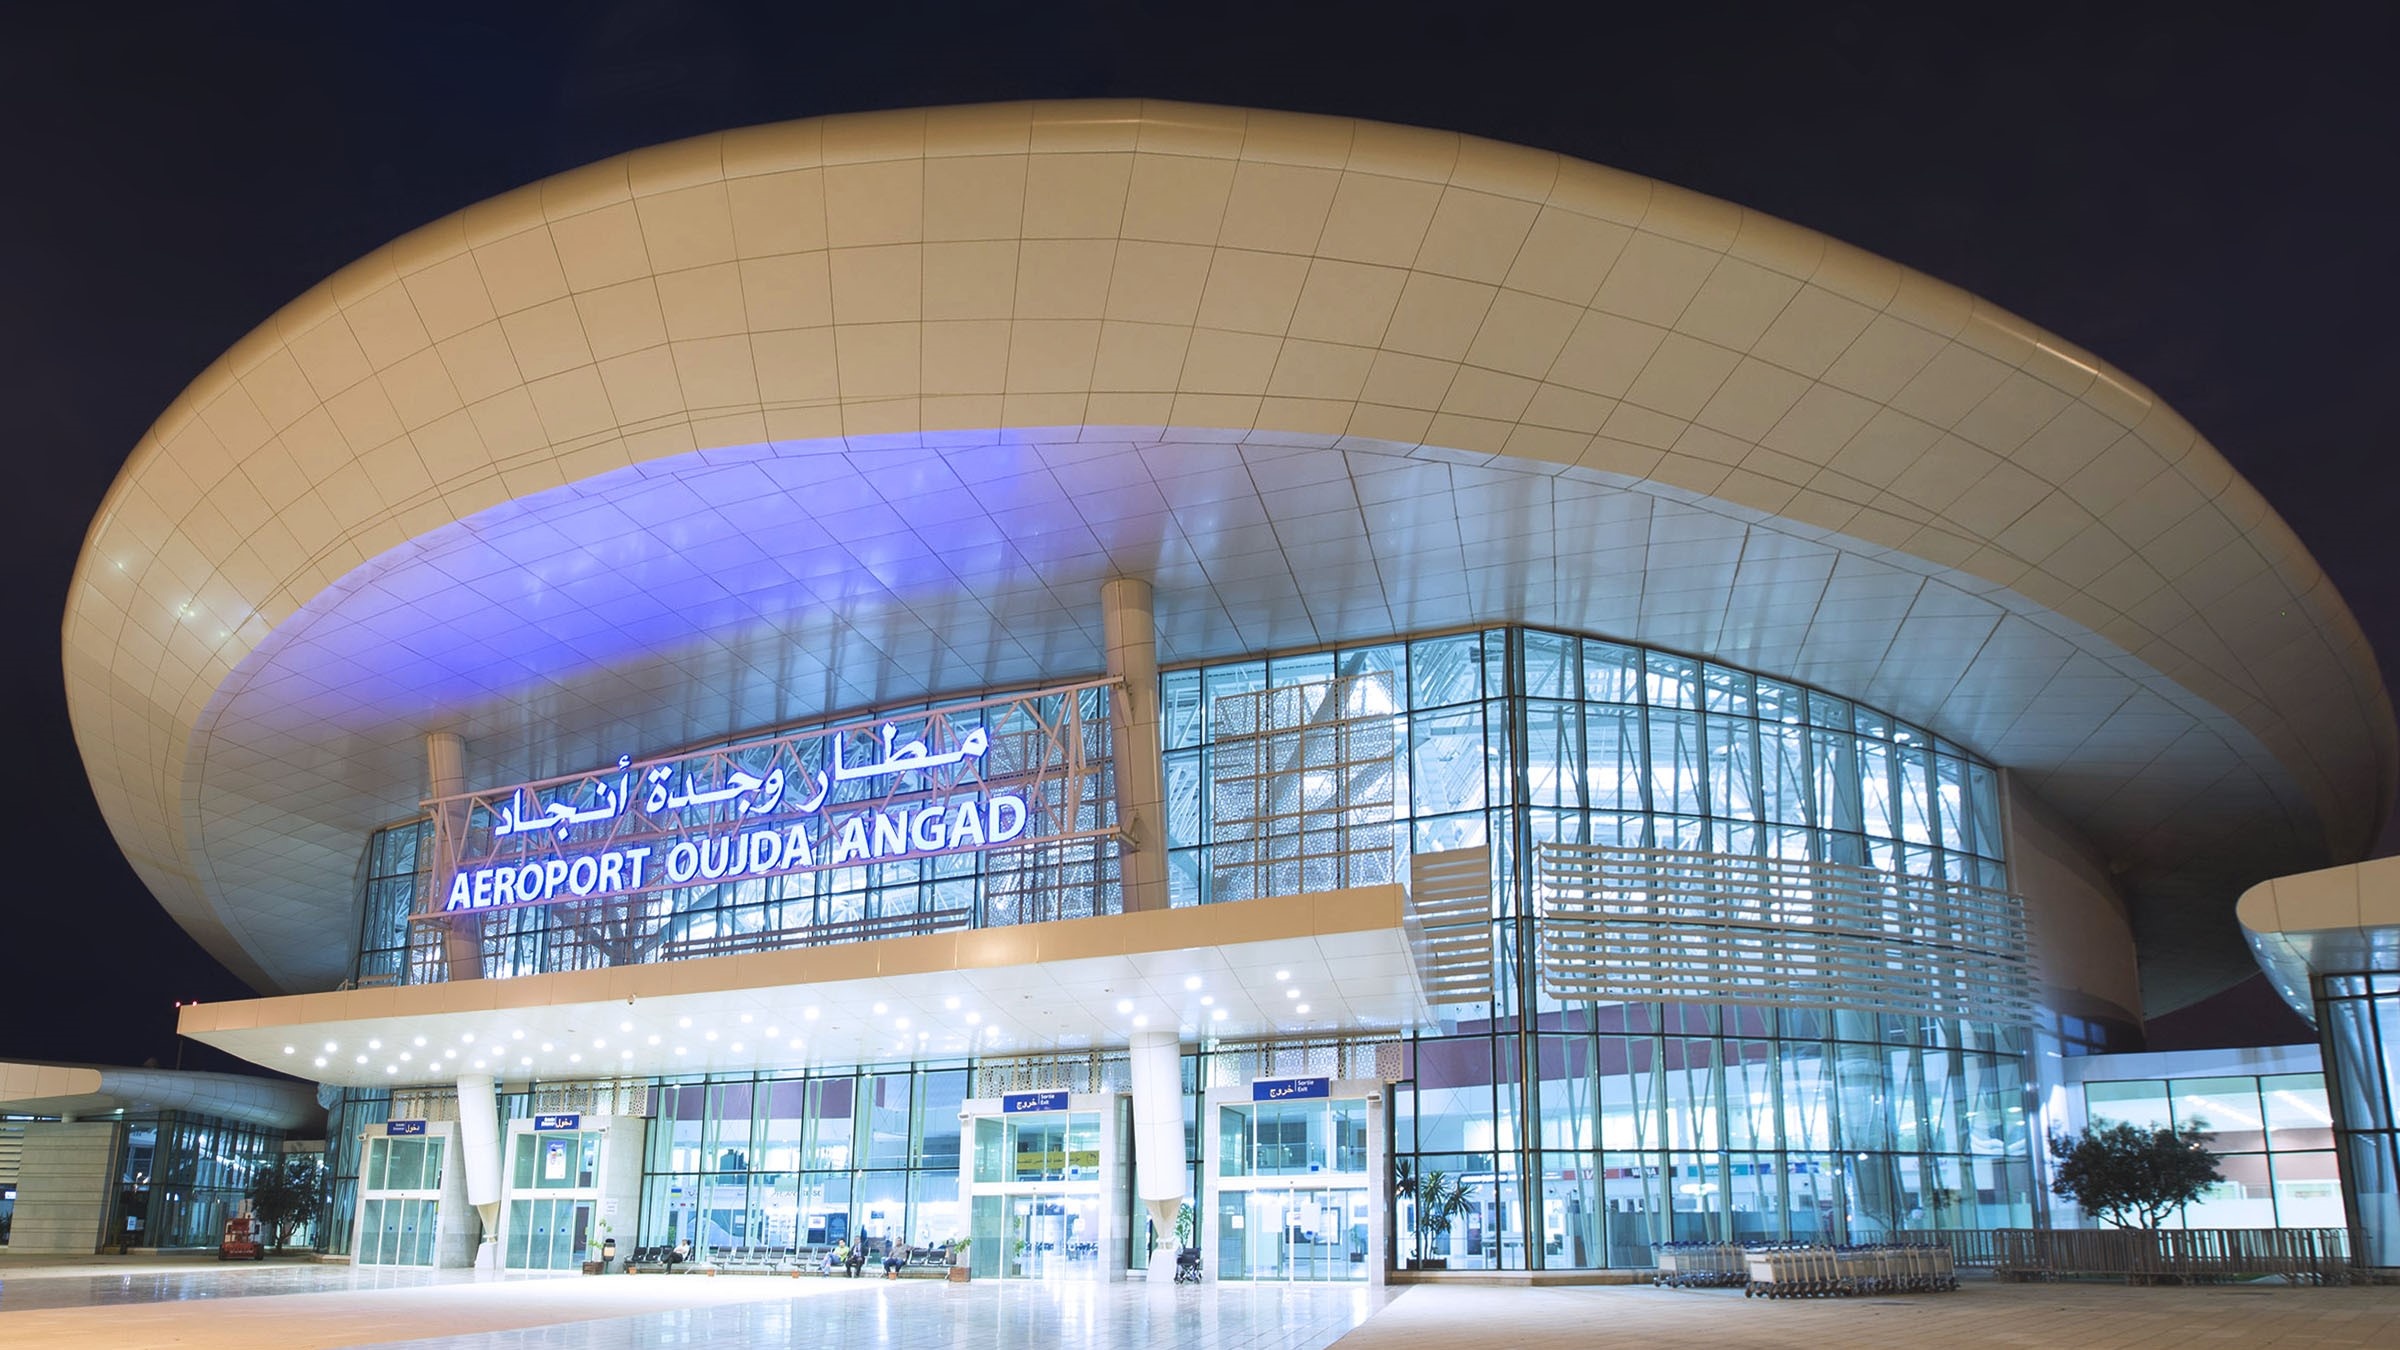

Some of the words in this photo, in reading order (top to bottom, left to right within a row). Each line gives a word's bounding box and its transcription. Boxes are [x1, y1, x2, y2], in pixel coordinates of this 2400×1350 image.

[797, 722, 989, 813] مطار
[494, 754, 632, 841] أنجاد
[646, 764, 785, 815] وجدة
[447, 847, 652, 911] AEROPORT
[667, 824, 814, 882] OUJDA
[838, 795, 1028, 863] ANGAD
[1016, 1098, 1037, 1110] خروج
[1269, 1084, 1294, 1098] خروج
[405, 1123, 420, 1133] دخول
[555, 1117, 573, 1128] دخول
